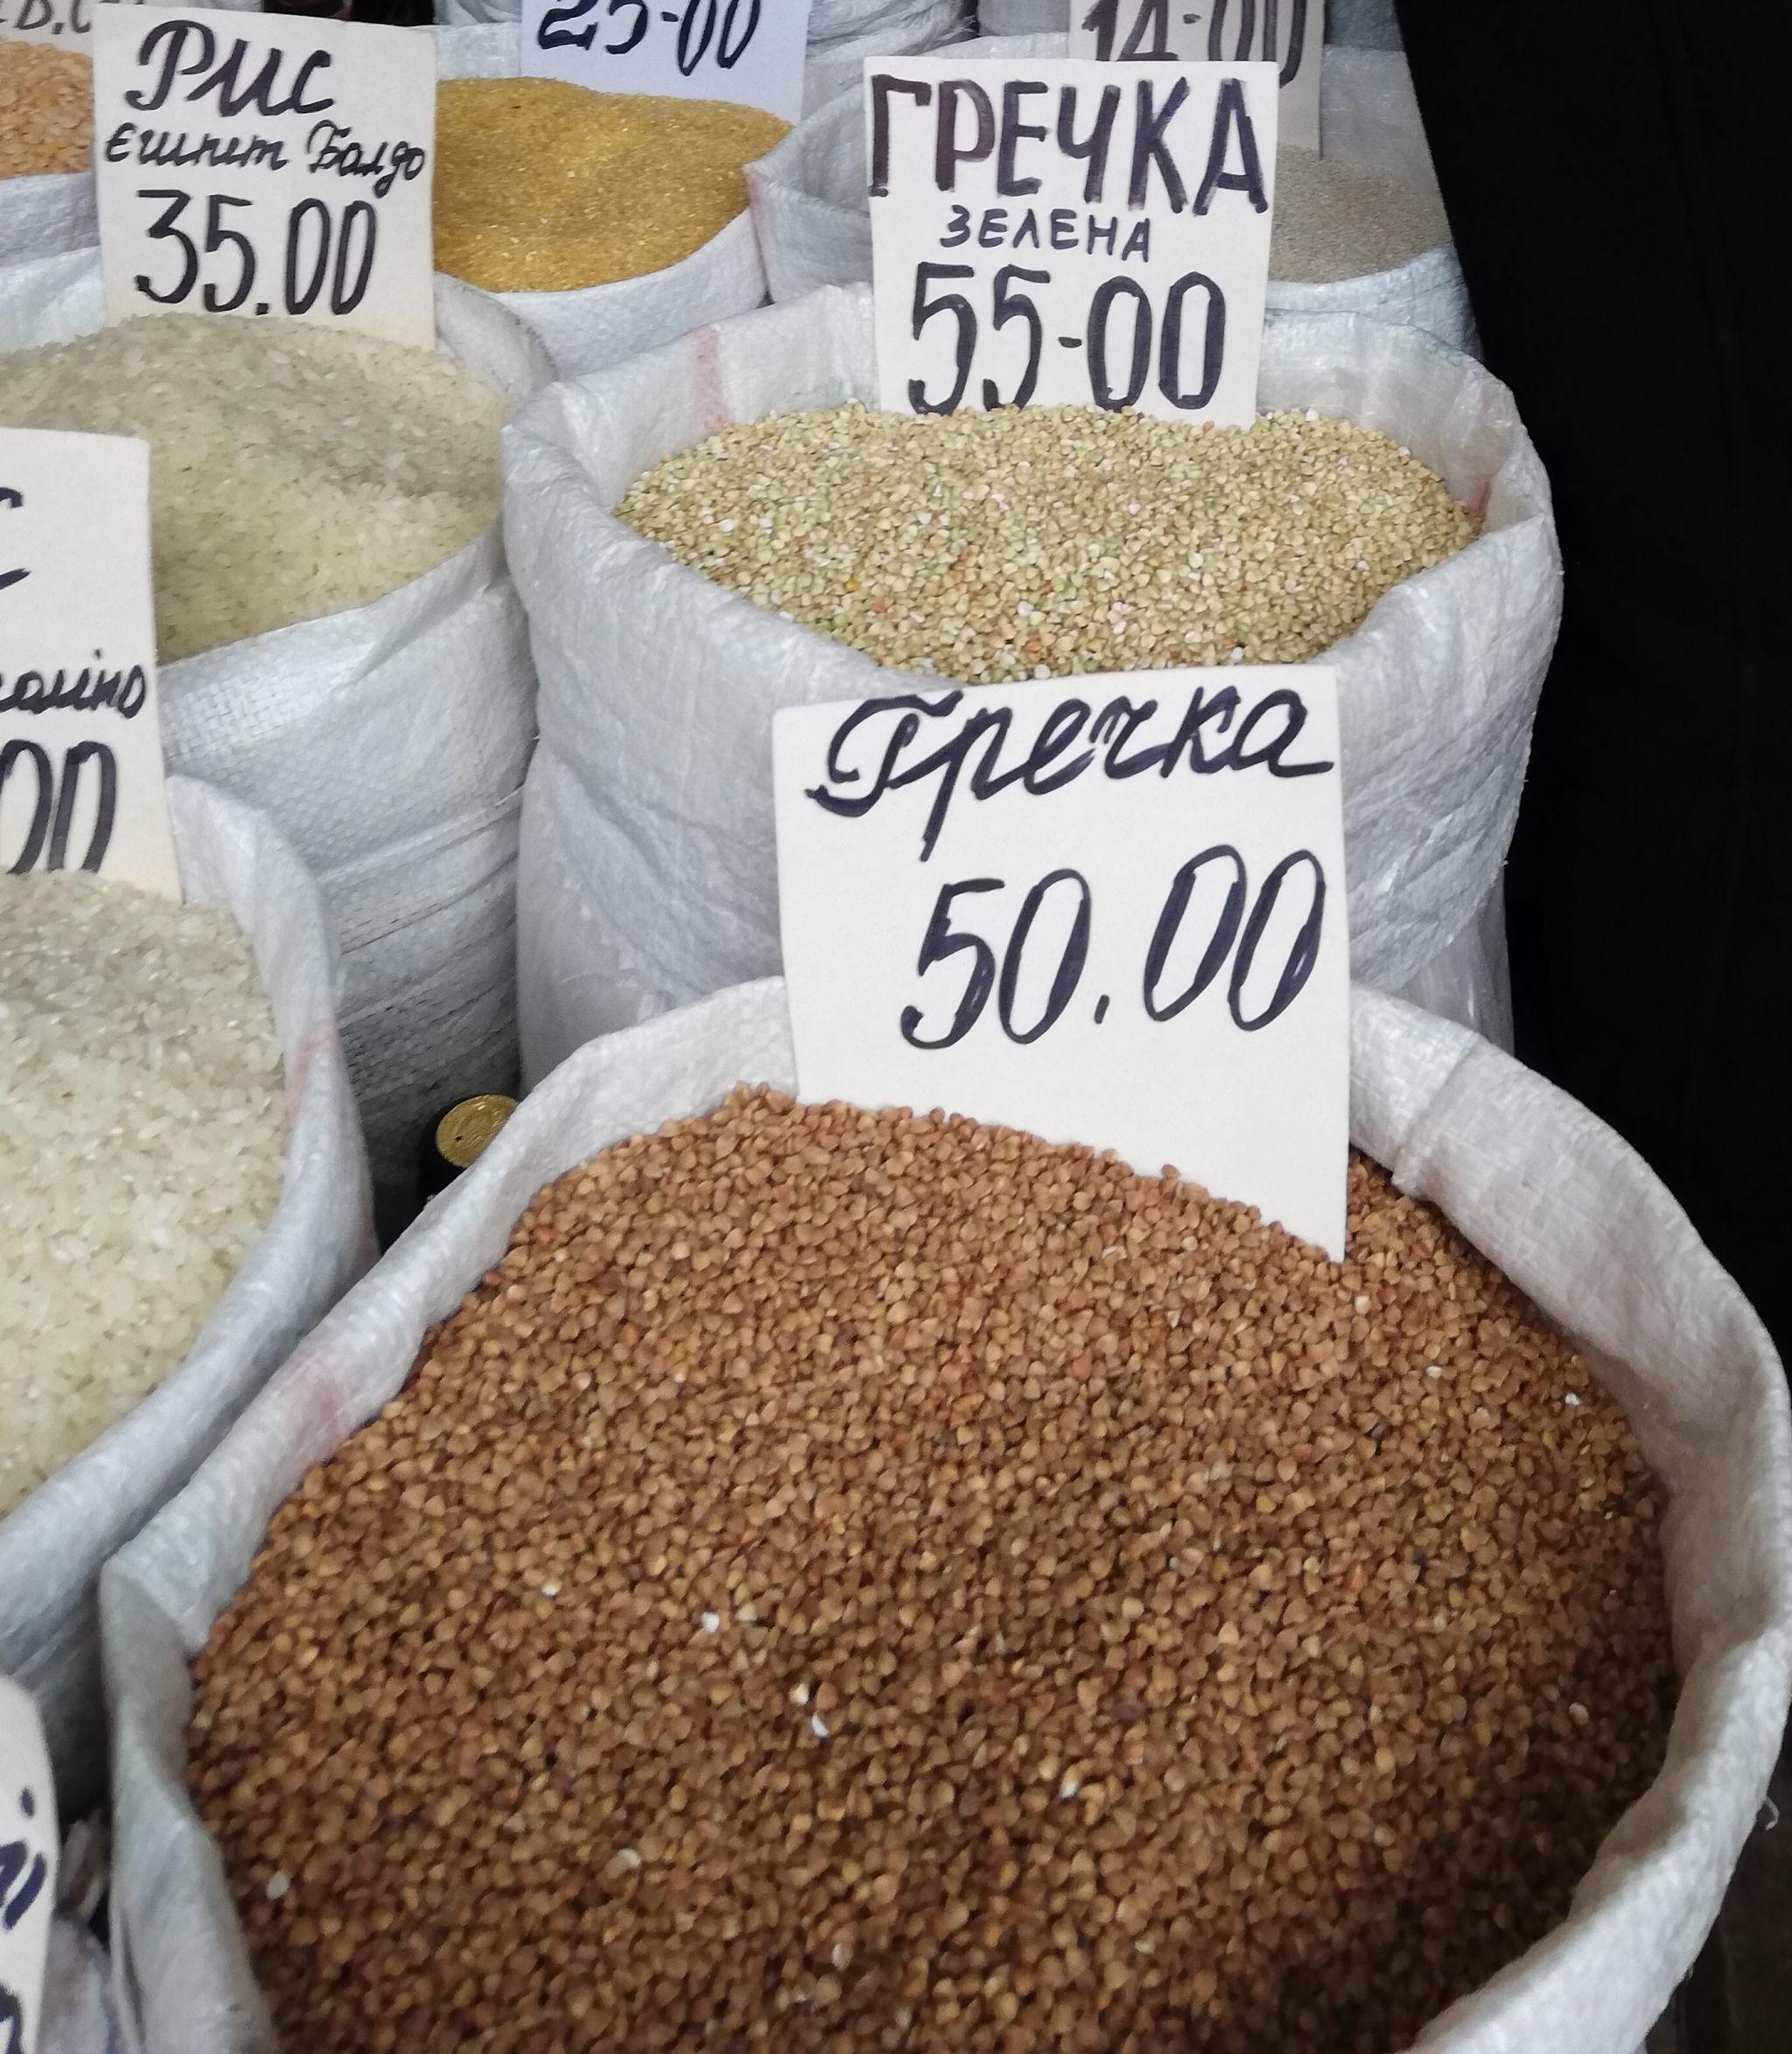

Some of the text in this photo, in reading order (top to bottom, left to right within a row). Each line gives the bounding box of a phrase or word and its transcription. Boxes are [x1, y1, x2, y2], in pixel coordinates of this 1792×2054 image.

[125, 19, 335, 117] Рис
[304, 119, 426, 199] Балдо
[867, 74, 1270, 216] ГРЕЧКА
[135, 188, 377, 316] 35.00
[940, 204, 1152, 263] ЗЕЛЕНА
[907, 261, 1227, 416] 55-00
[804, 685, 1335, 862] Гречка
[900, 844, 1326, 1050] 50.00
